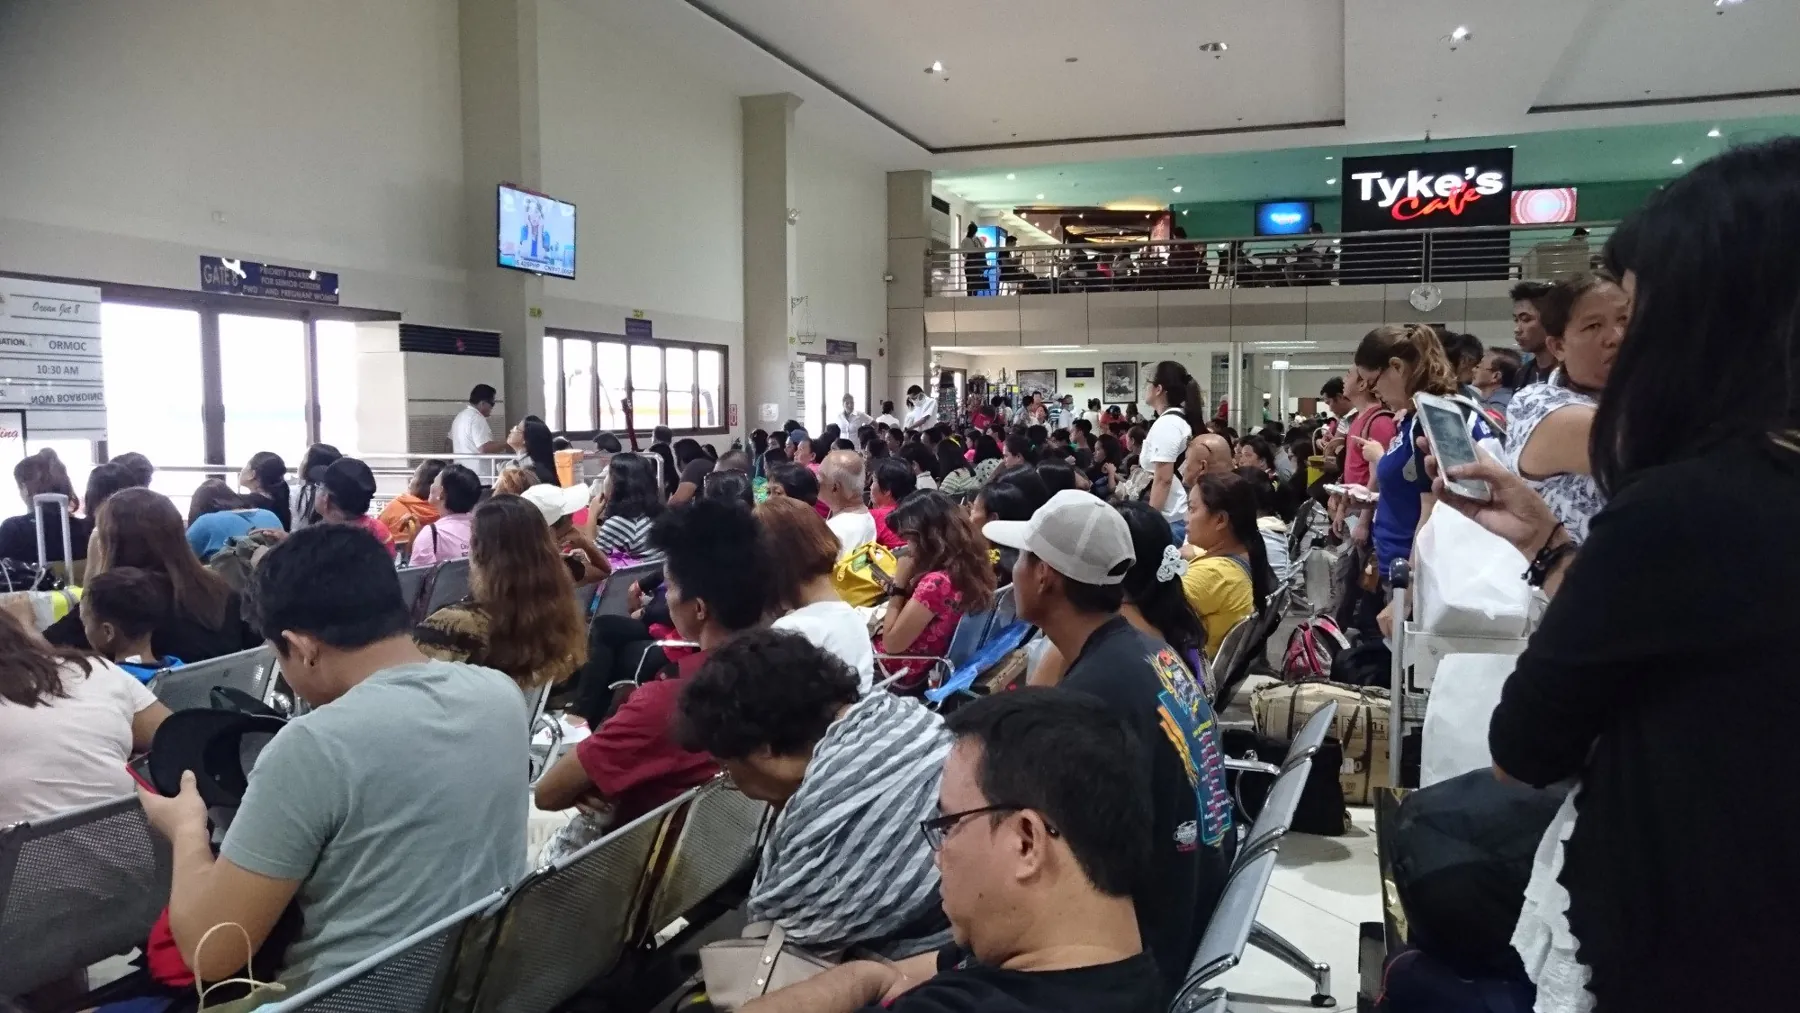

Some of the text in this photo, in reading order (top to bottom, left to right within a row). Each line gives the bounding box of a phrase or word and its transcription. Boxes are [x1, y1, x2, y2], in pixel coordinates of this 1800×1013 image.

[1351, 166, 1503, 207] Tyke's
[203, 264, 230, 285] GATE
[260, 266, 287, 277] PRIORITY
[261, 276, 321, 291] FOR SENIOR CITIZEN
[265, 288, 279, 296] AND
[32, 301, 57, 314] Ocean
[48, 340, 87, 351] ORMOC
[37, 364, 79, 375] 10:30 AM
